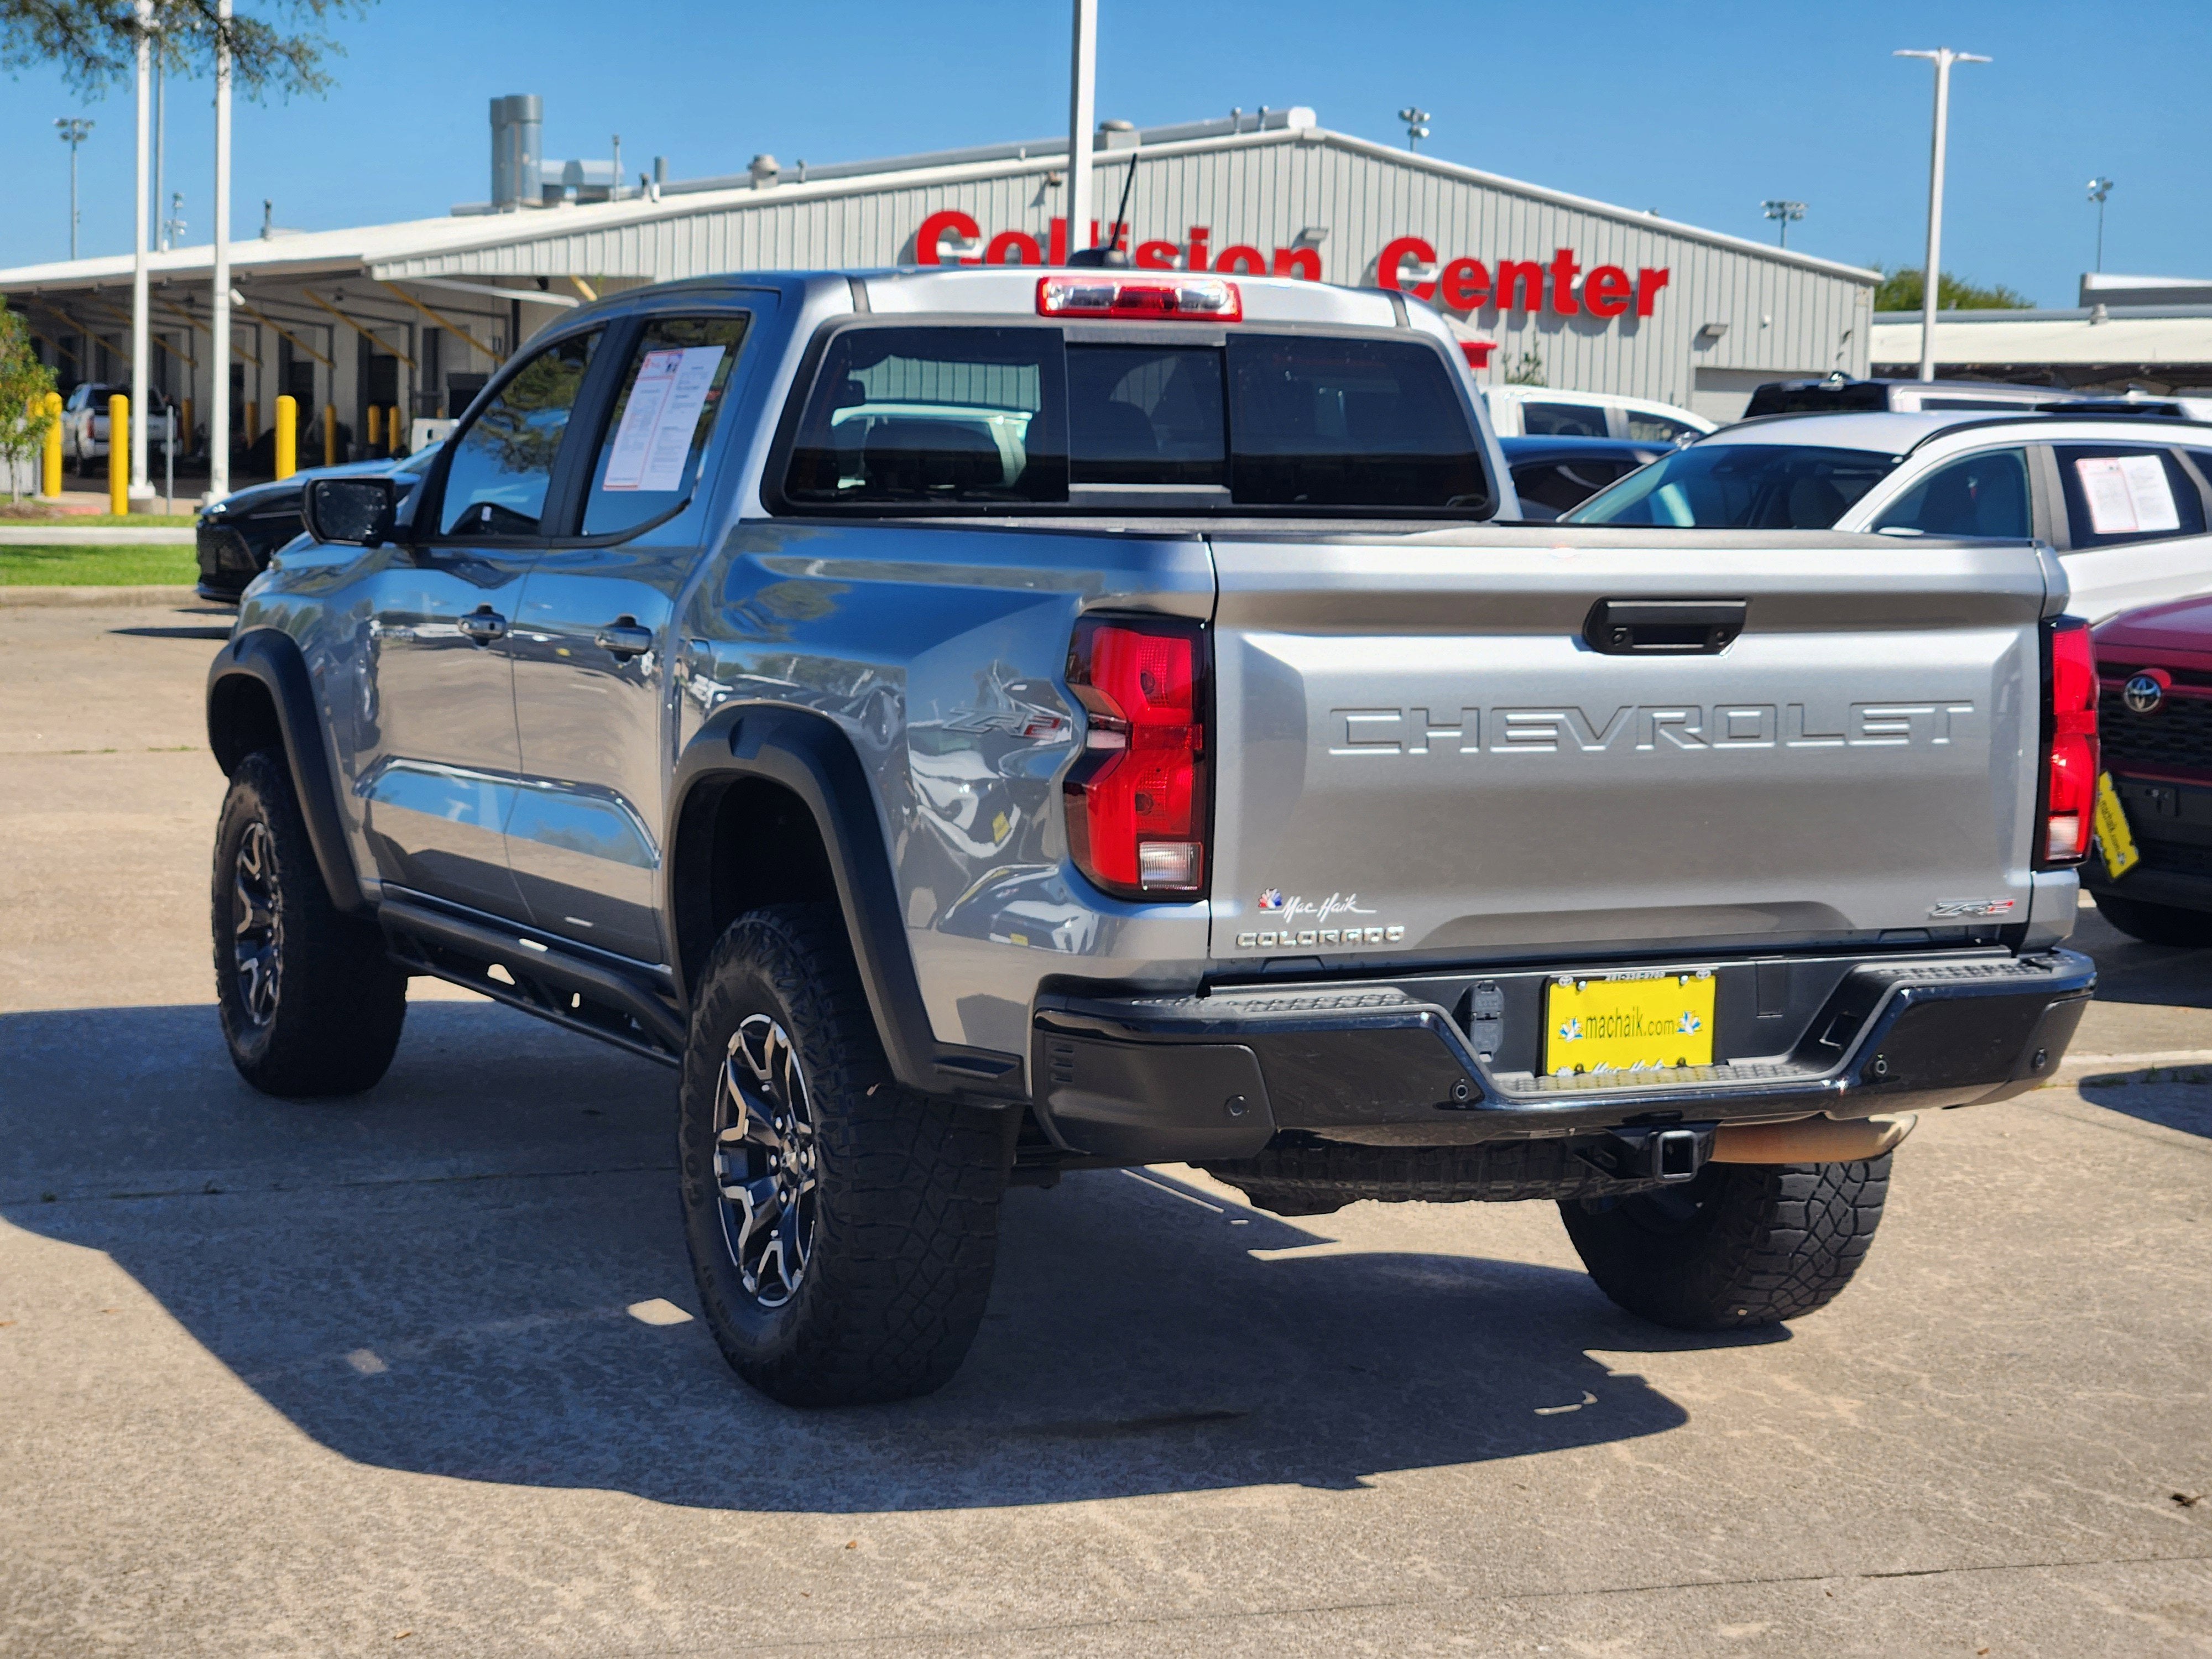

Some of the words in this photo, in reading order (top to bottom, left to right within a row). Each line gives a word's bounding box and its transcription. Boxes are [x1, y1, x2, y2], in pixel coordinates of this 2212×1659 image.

[917, 210, 1321, 282] Colsion
[1378, 237, 1670, 317] Center
[941, 708, 1062, 740] ZR2
[1328, 701, 1974, 754] CHEVROLET
[1281, 896, 1317, 924] Mac
[1316, 892, 1358, 923] Haik
[1237, 926, 1405, 947] COLORADO
[1585, 1006, 1674, 1039] machaik.com
